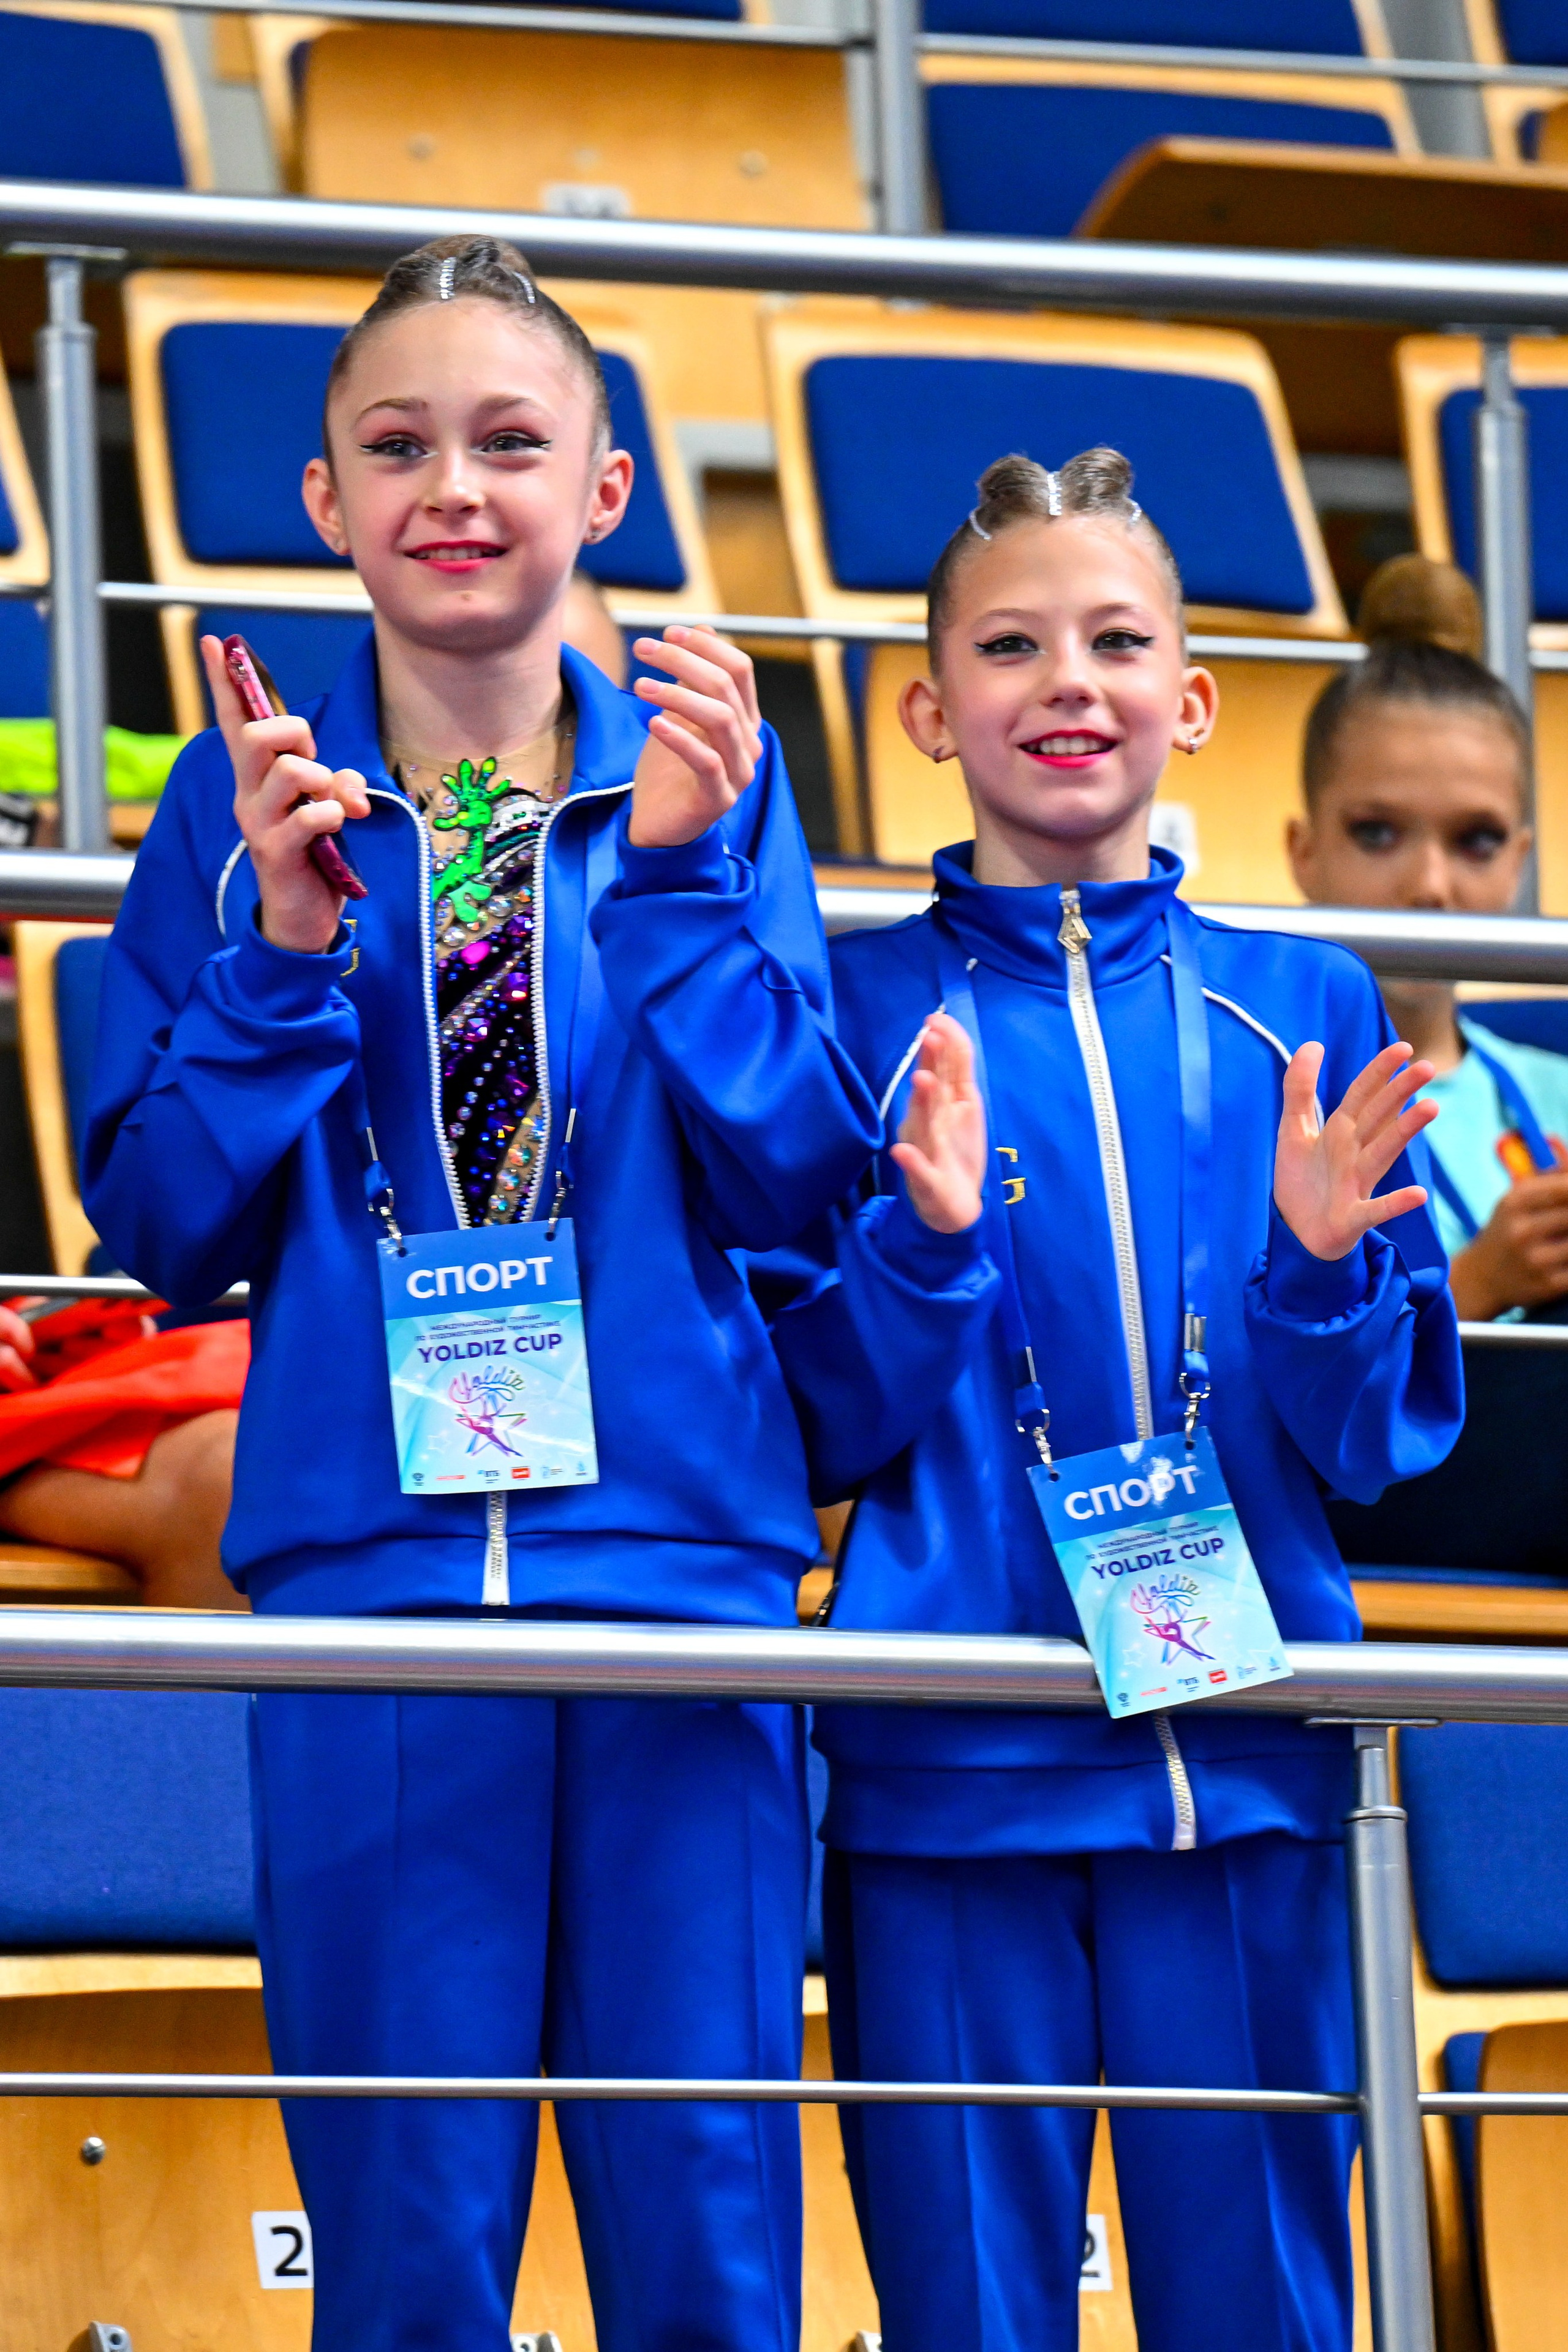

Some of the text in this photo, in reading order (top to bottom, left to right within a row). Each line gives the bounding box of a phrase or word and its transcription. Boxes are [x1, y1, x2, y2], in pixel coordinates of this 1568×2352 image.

[406, 1256, 553, 1298] СПОРТ
[418, 1333, 562, 1363] YOLDIZ CUP
[1064, 1464, 1197, 1520] СПОРТ
[1091, 1537, 1224, 1580] YOLDIZ CUP
[270, 2225, 308, 2277] 2
